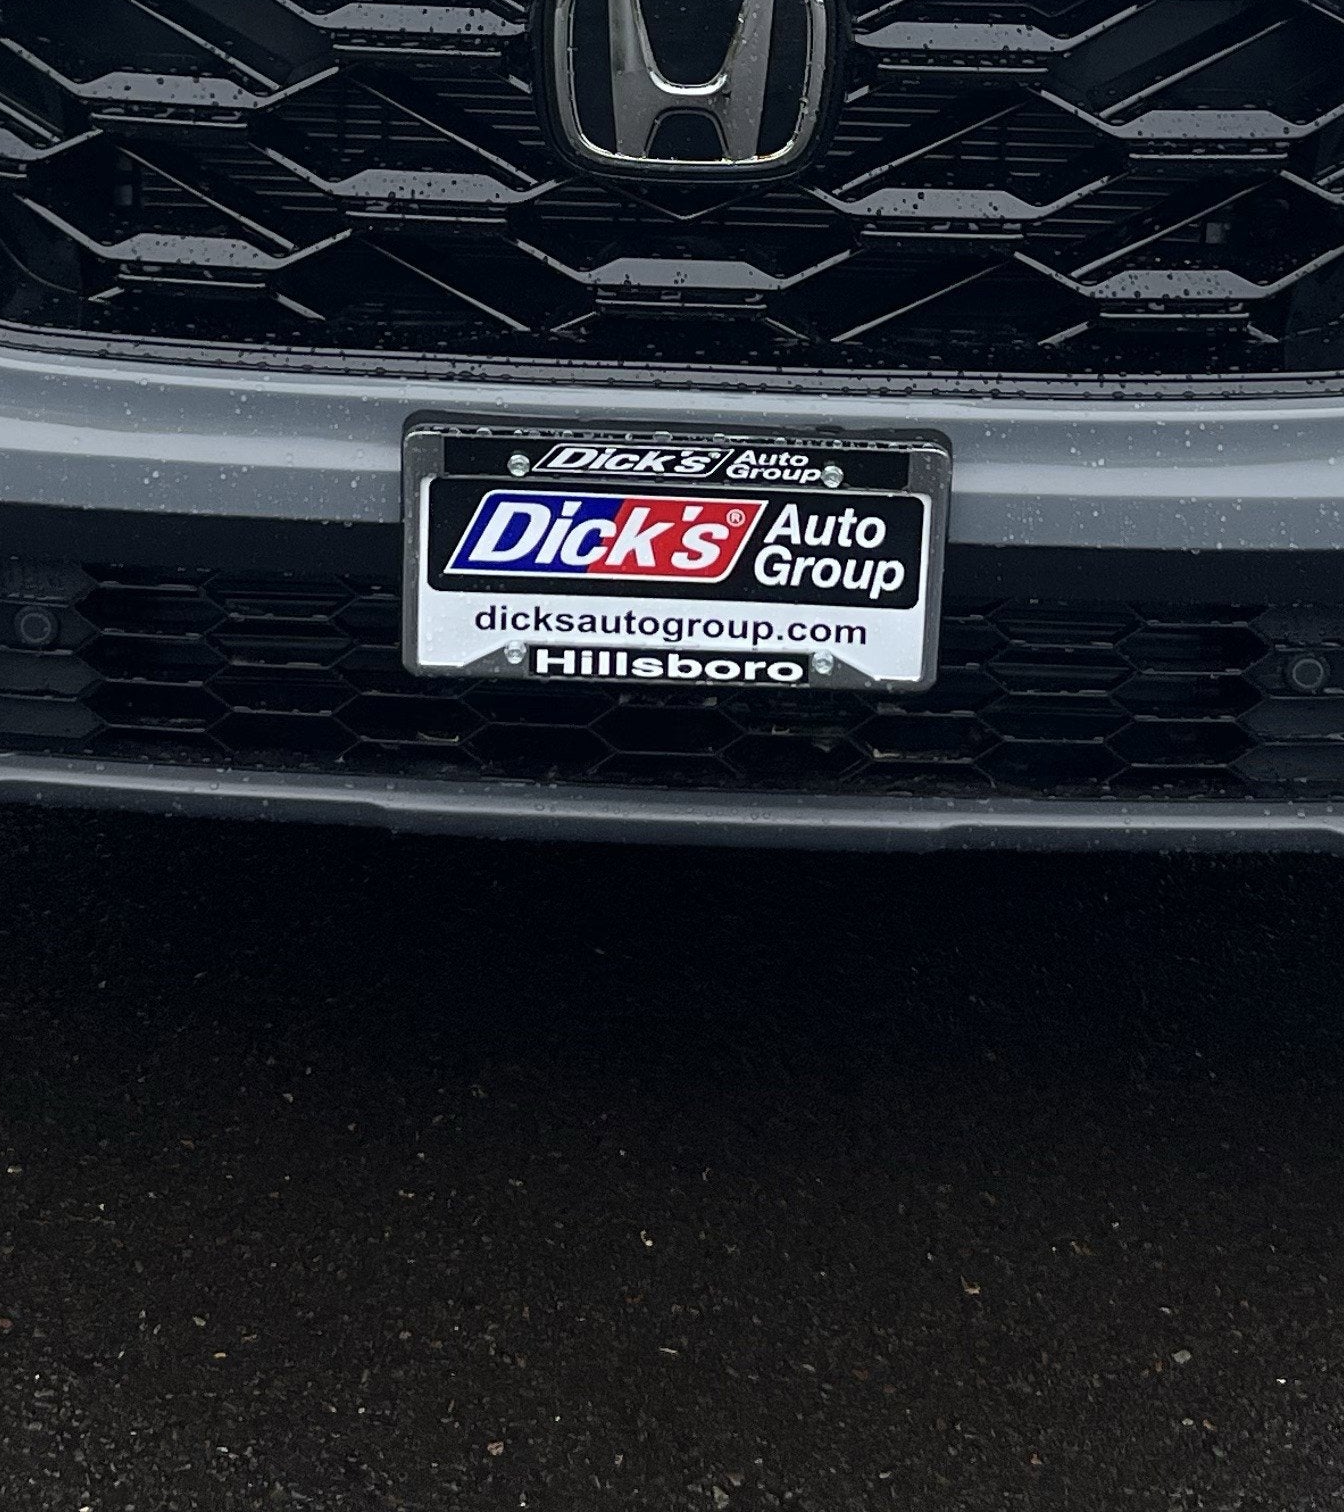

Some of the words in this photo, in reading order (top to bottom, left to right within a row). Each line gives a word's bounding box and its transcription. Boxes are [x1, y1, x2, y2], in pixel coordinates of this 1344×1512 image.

[726, 464, 821, 484] Group
[733, 449, 809, 467] Auto
[763, 503, 887, 549] Auto
[754, 545, 905, 599] Group
[474, 605, 867, 645] dicksautogroup.com
[535, 648, 804, 682] Hillsboro
